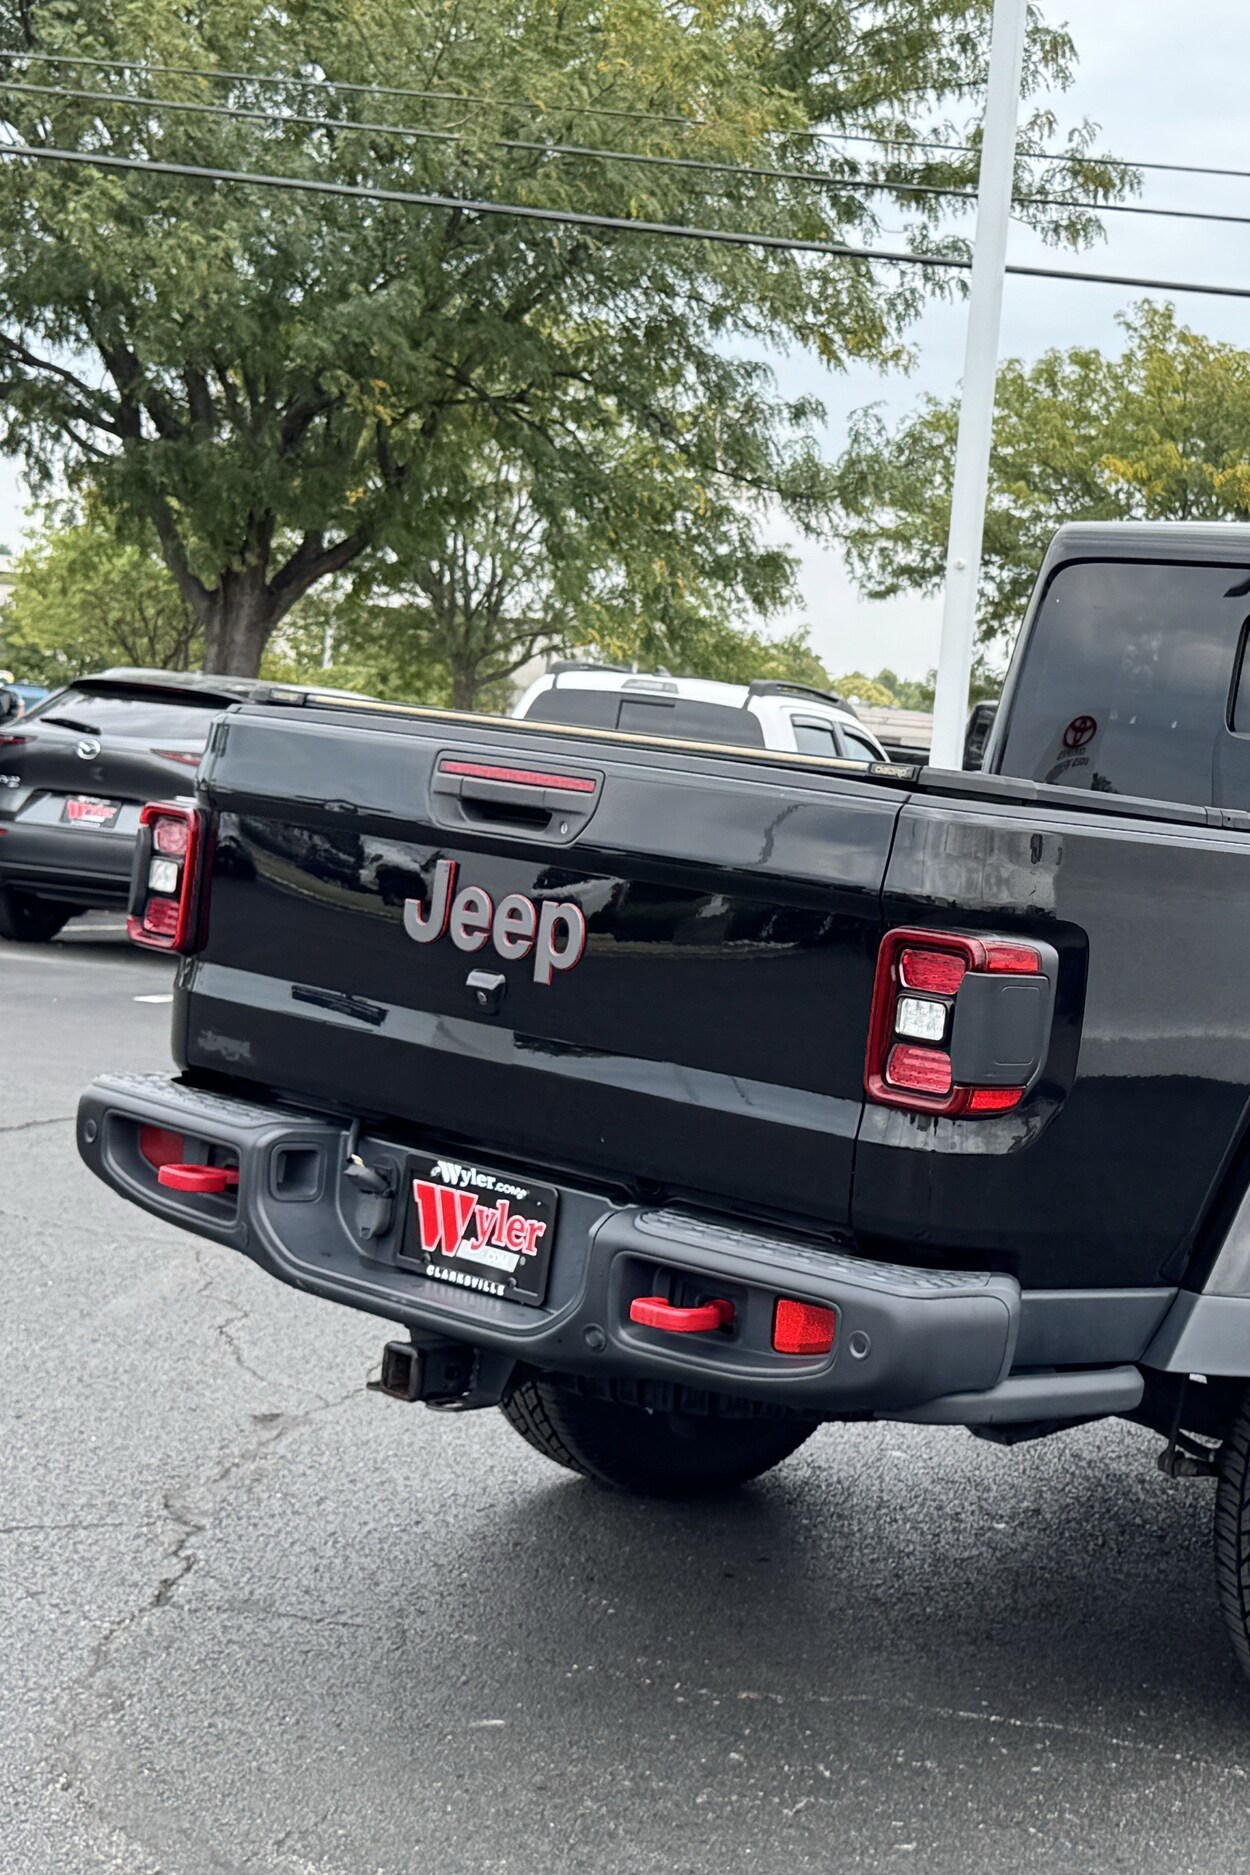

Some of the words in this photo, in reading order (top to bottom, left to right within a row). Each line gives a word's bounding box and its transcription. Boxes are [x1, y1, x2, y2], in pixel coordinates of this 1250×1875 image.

[404, 859, 588, 986] Jeep
[413, 1179, 547, 1257] Wyler
[426, 1265, 505, 1297] CLARKSVILLE
